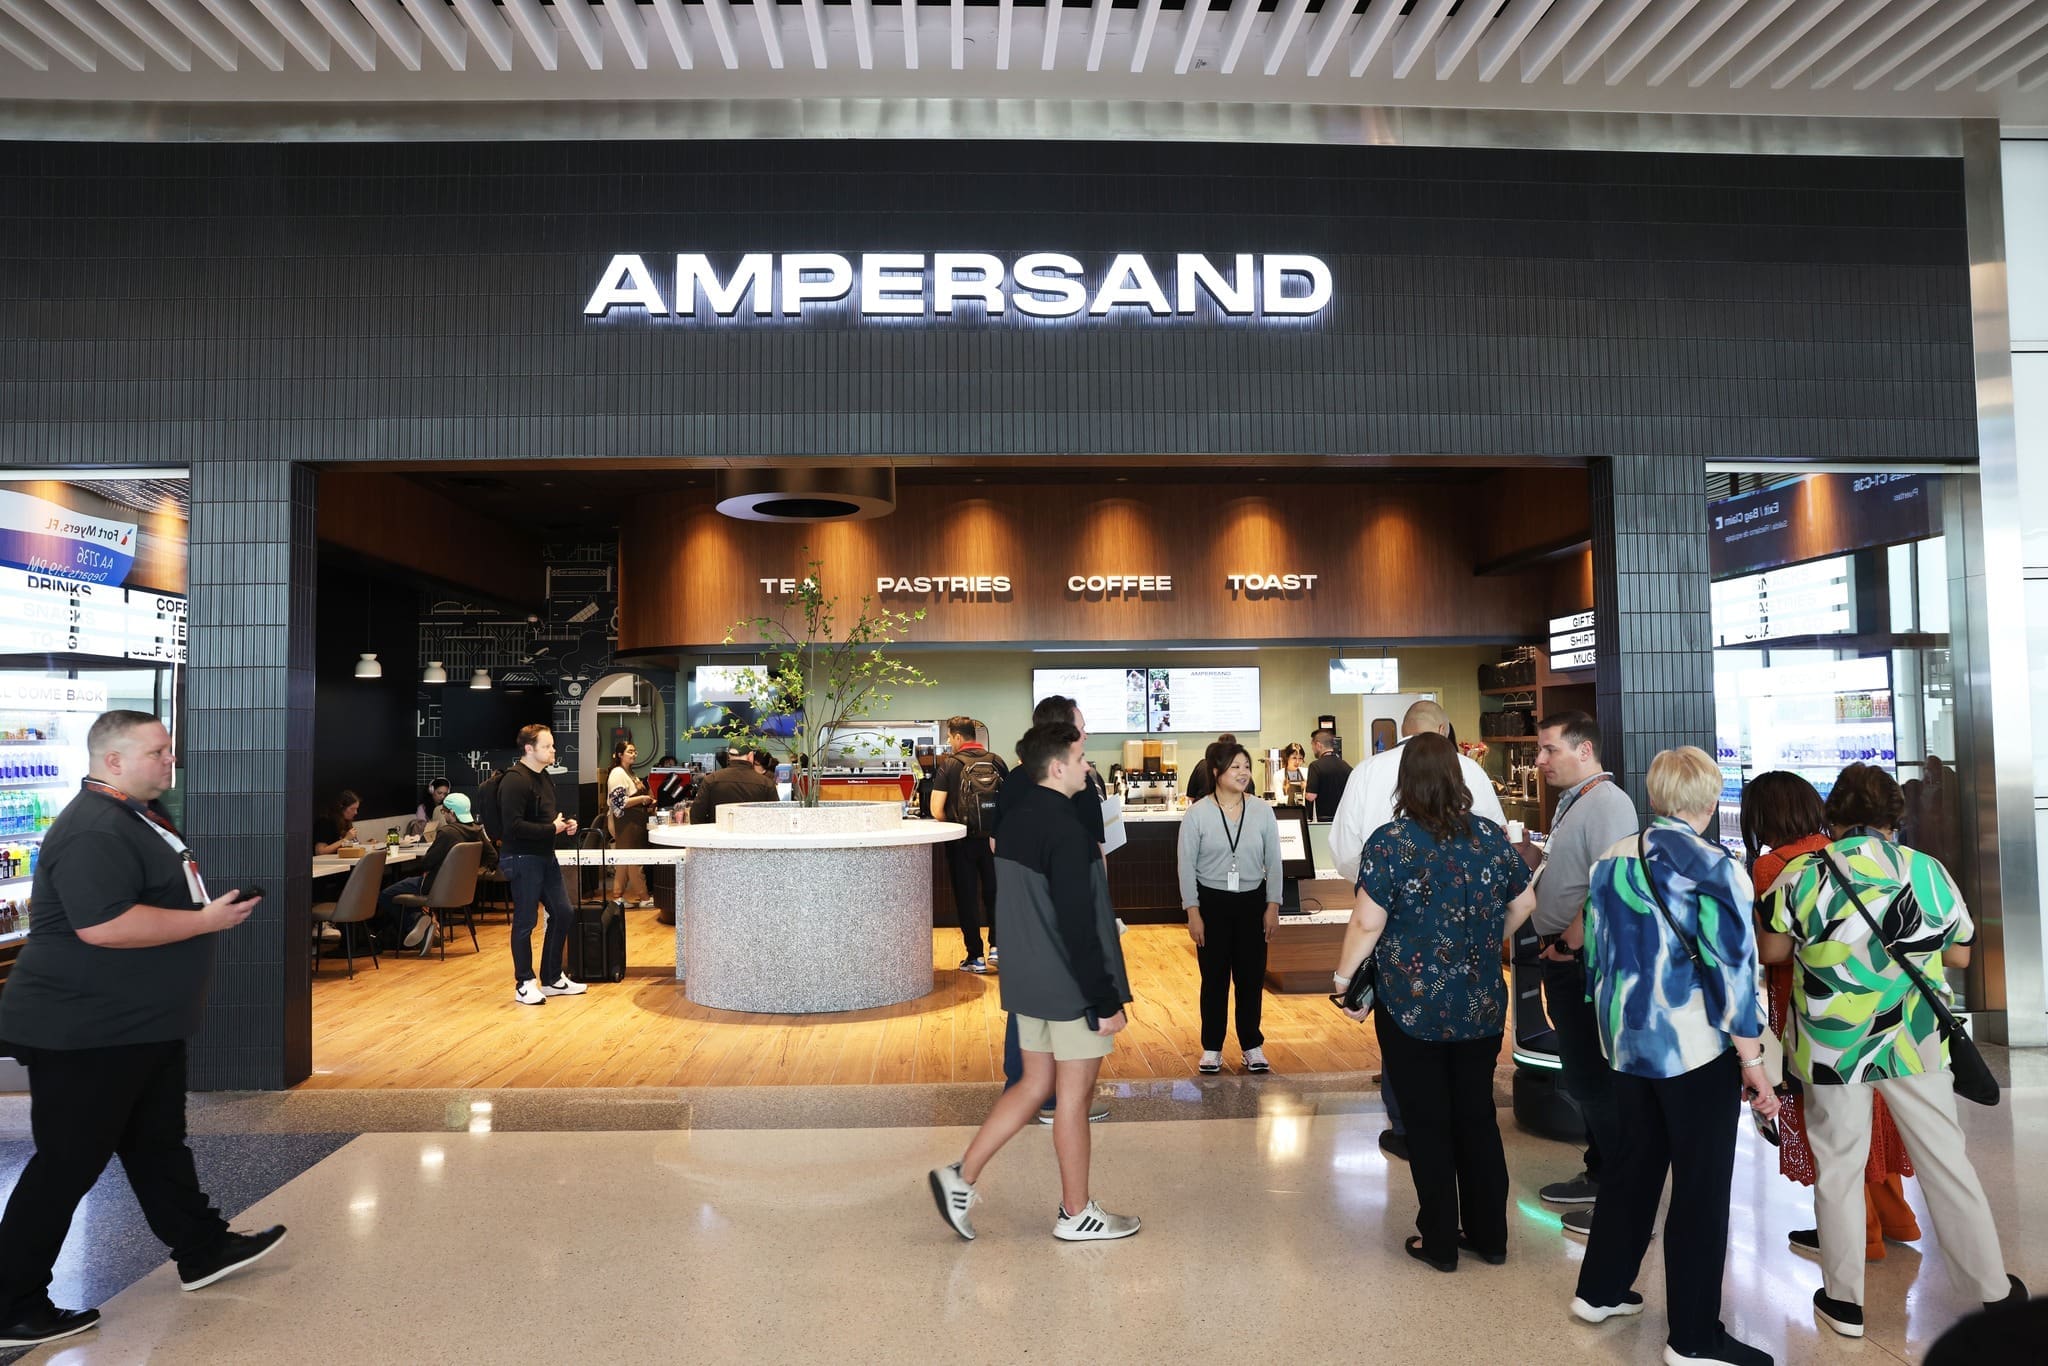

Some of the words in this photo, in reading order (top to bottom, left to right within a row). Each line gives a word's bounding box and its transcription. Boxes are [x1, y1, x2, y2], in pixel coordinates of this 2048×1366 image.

[583, 252, 1334, 317] AMPERSAND
[27, 574, 92, 597] DRINKS
[877, 576, 1011, 593] PASTRIES
[1068, 575, 1171, 591] COFFEE
[1228, 574, 1317, 590] TOAST
[18, 686, 61, 700] COME
[66, 688, 103, 702] BACK
